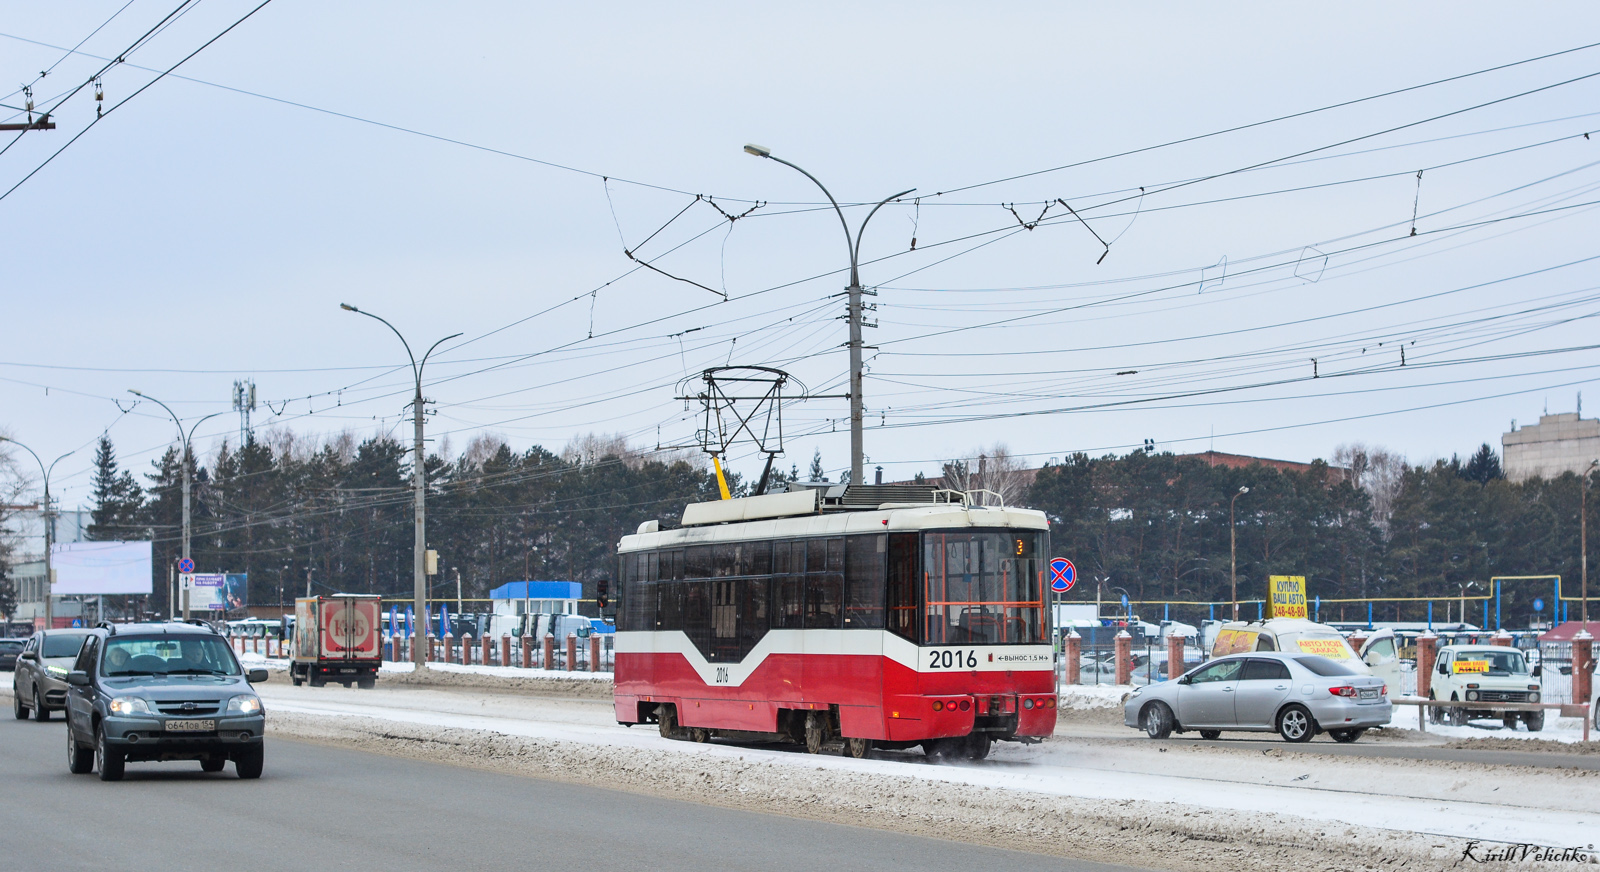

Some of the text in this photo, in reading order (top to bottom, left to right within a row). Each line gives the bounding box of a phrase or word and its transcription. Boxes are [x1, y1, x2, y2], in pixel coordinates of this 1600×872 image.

[1016, 539, 1023, 555] 3
[1276, 581, 1300, 592] КУПЛЮ
[1273, 592, 1305, 605] ВАШ АВТО
[1274, 606, 1306, 617] 248-48-80
[929, 650, 978, 668] 2016
[716, 667, 729, 683] 2016
